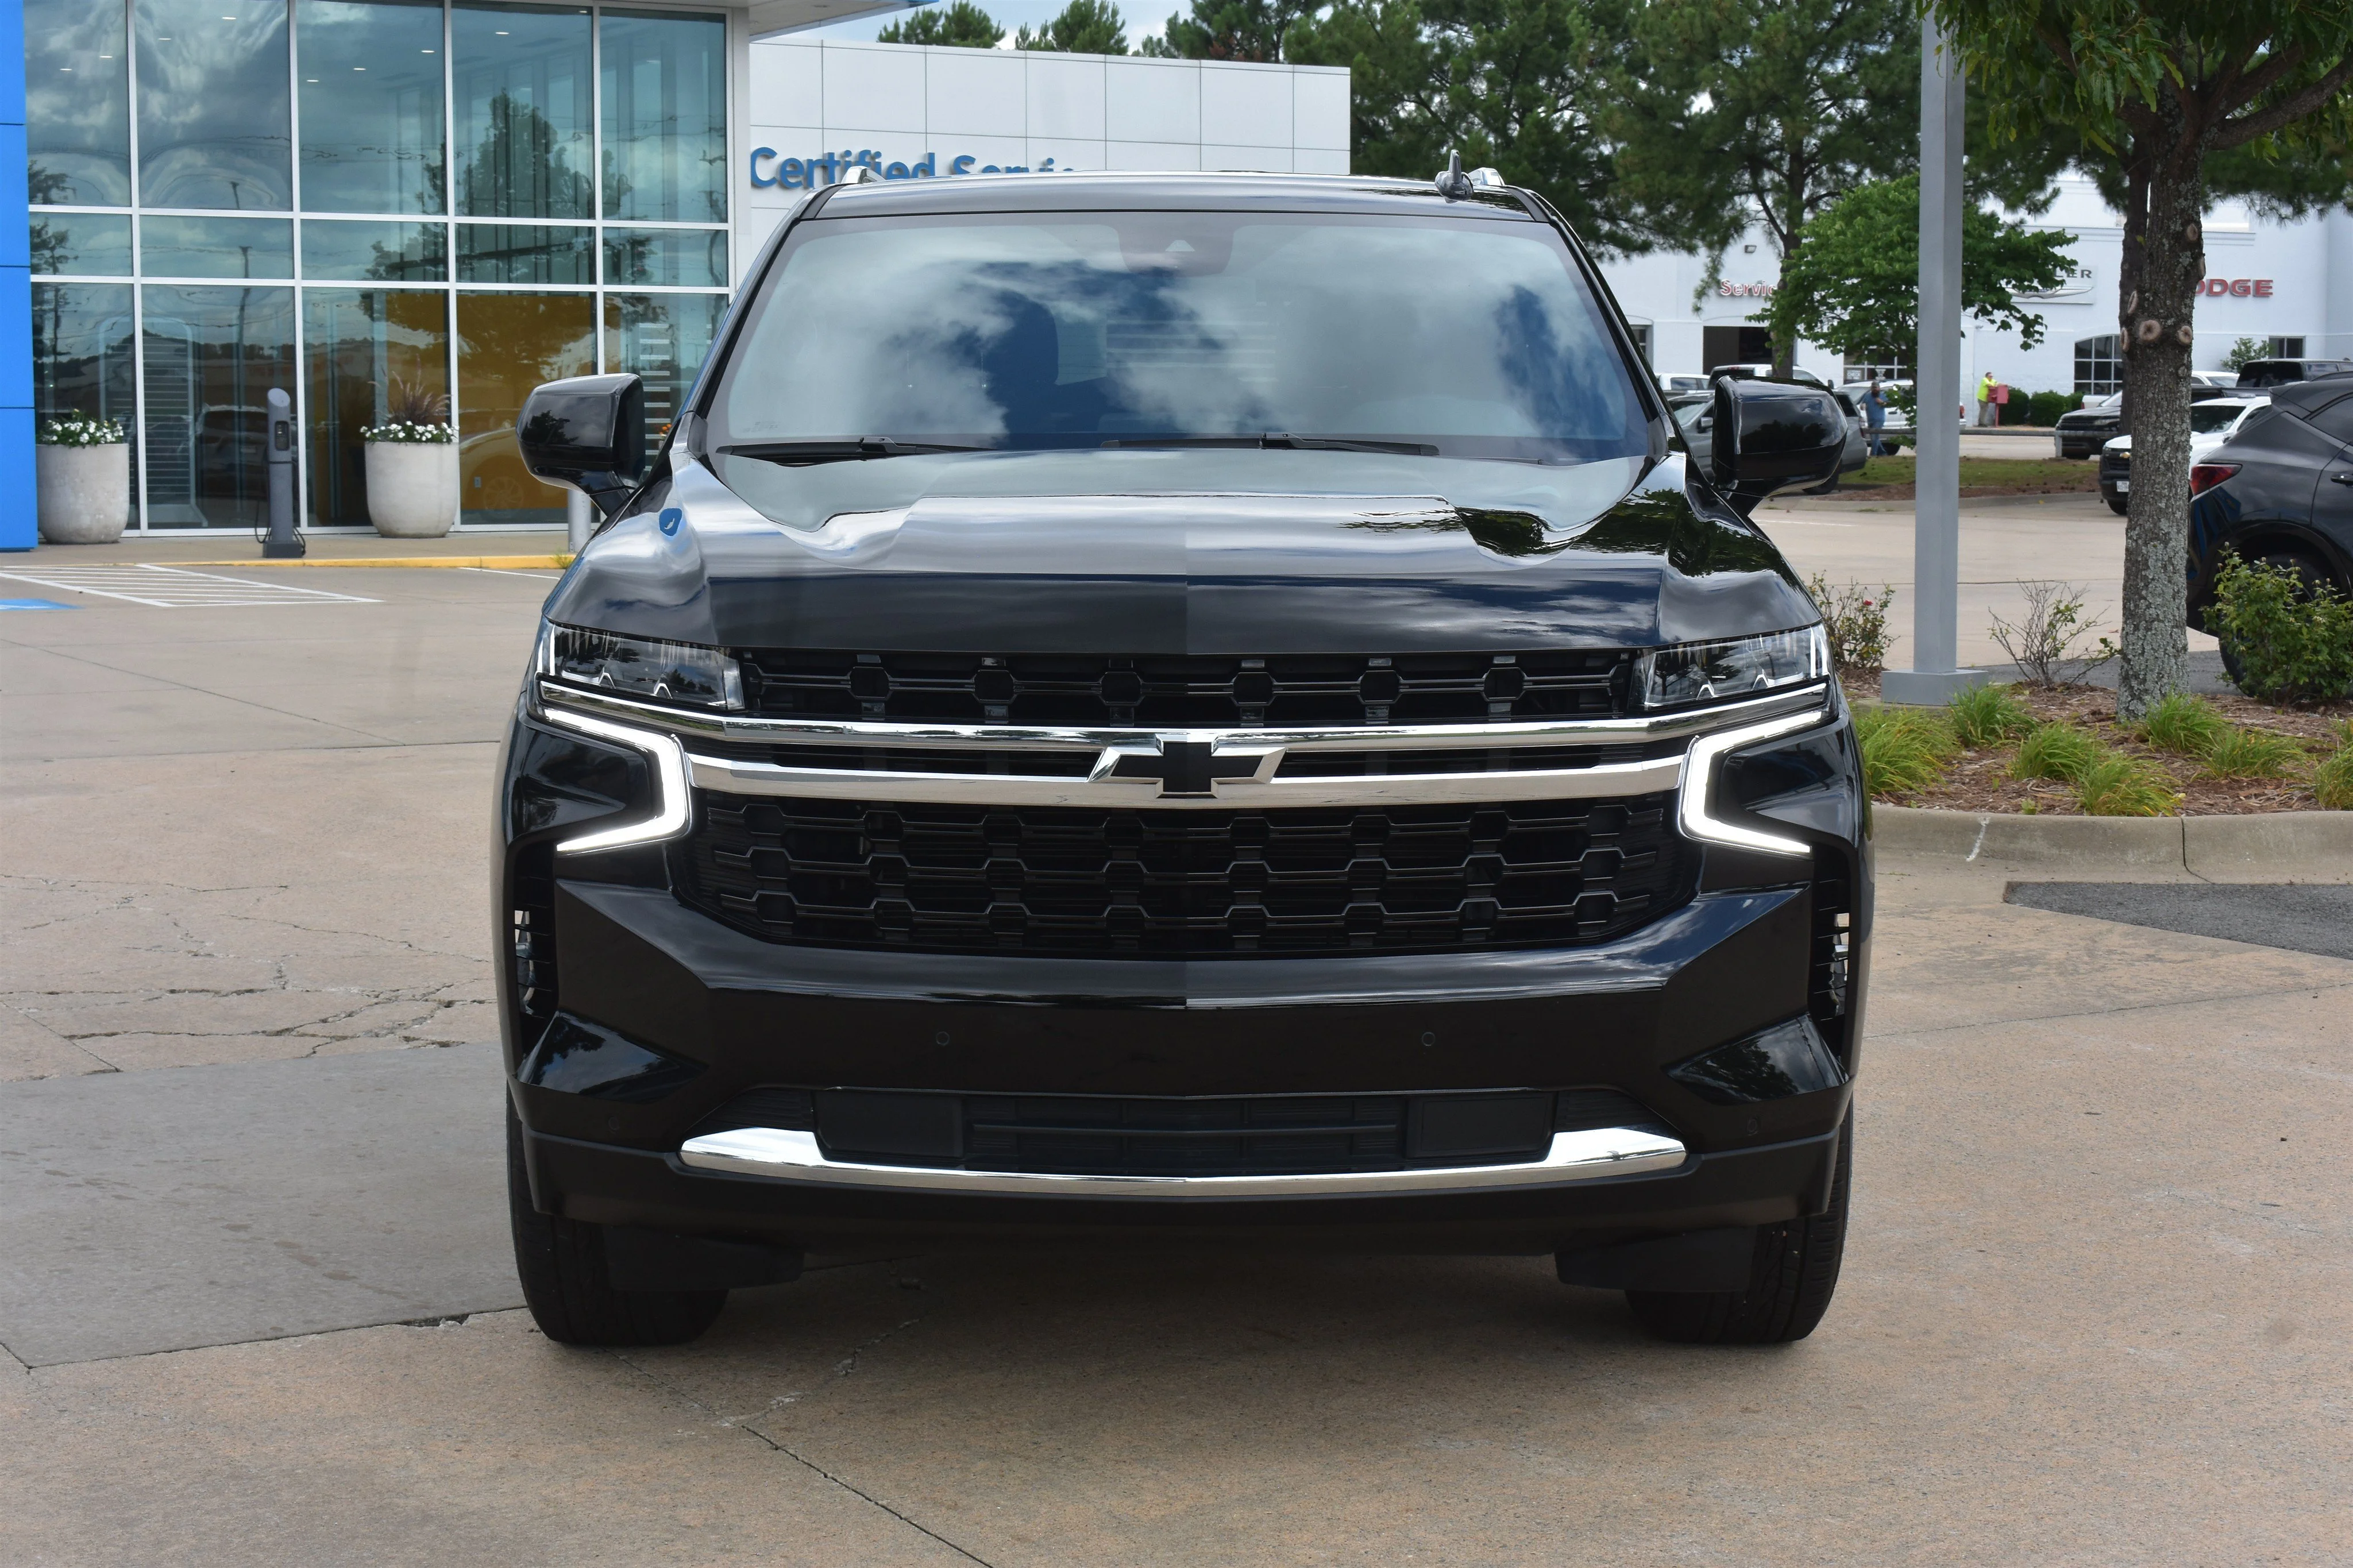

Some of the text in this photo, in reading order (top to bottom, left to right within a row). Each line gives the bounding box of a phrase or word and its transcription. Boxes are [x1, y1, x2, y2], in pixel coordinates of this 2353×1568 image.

[750, 147, 935, 188] Certified
[1721, 279, 1777, 296] Servic
[2195, 279, 2273, 296] DGE
